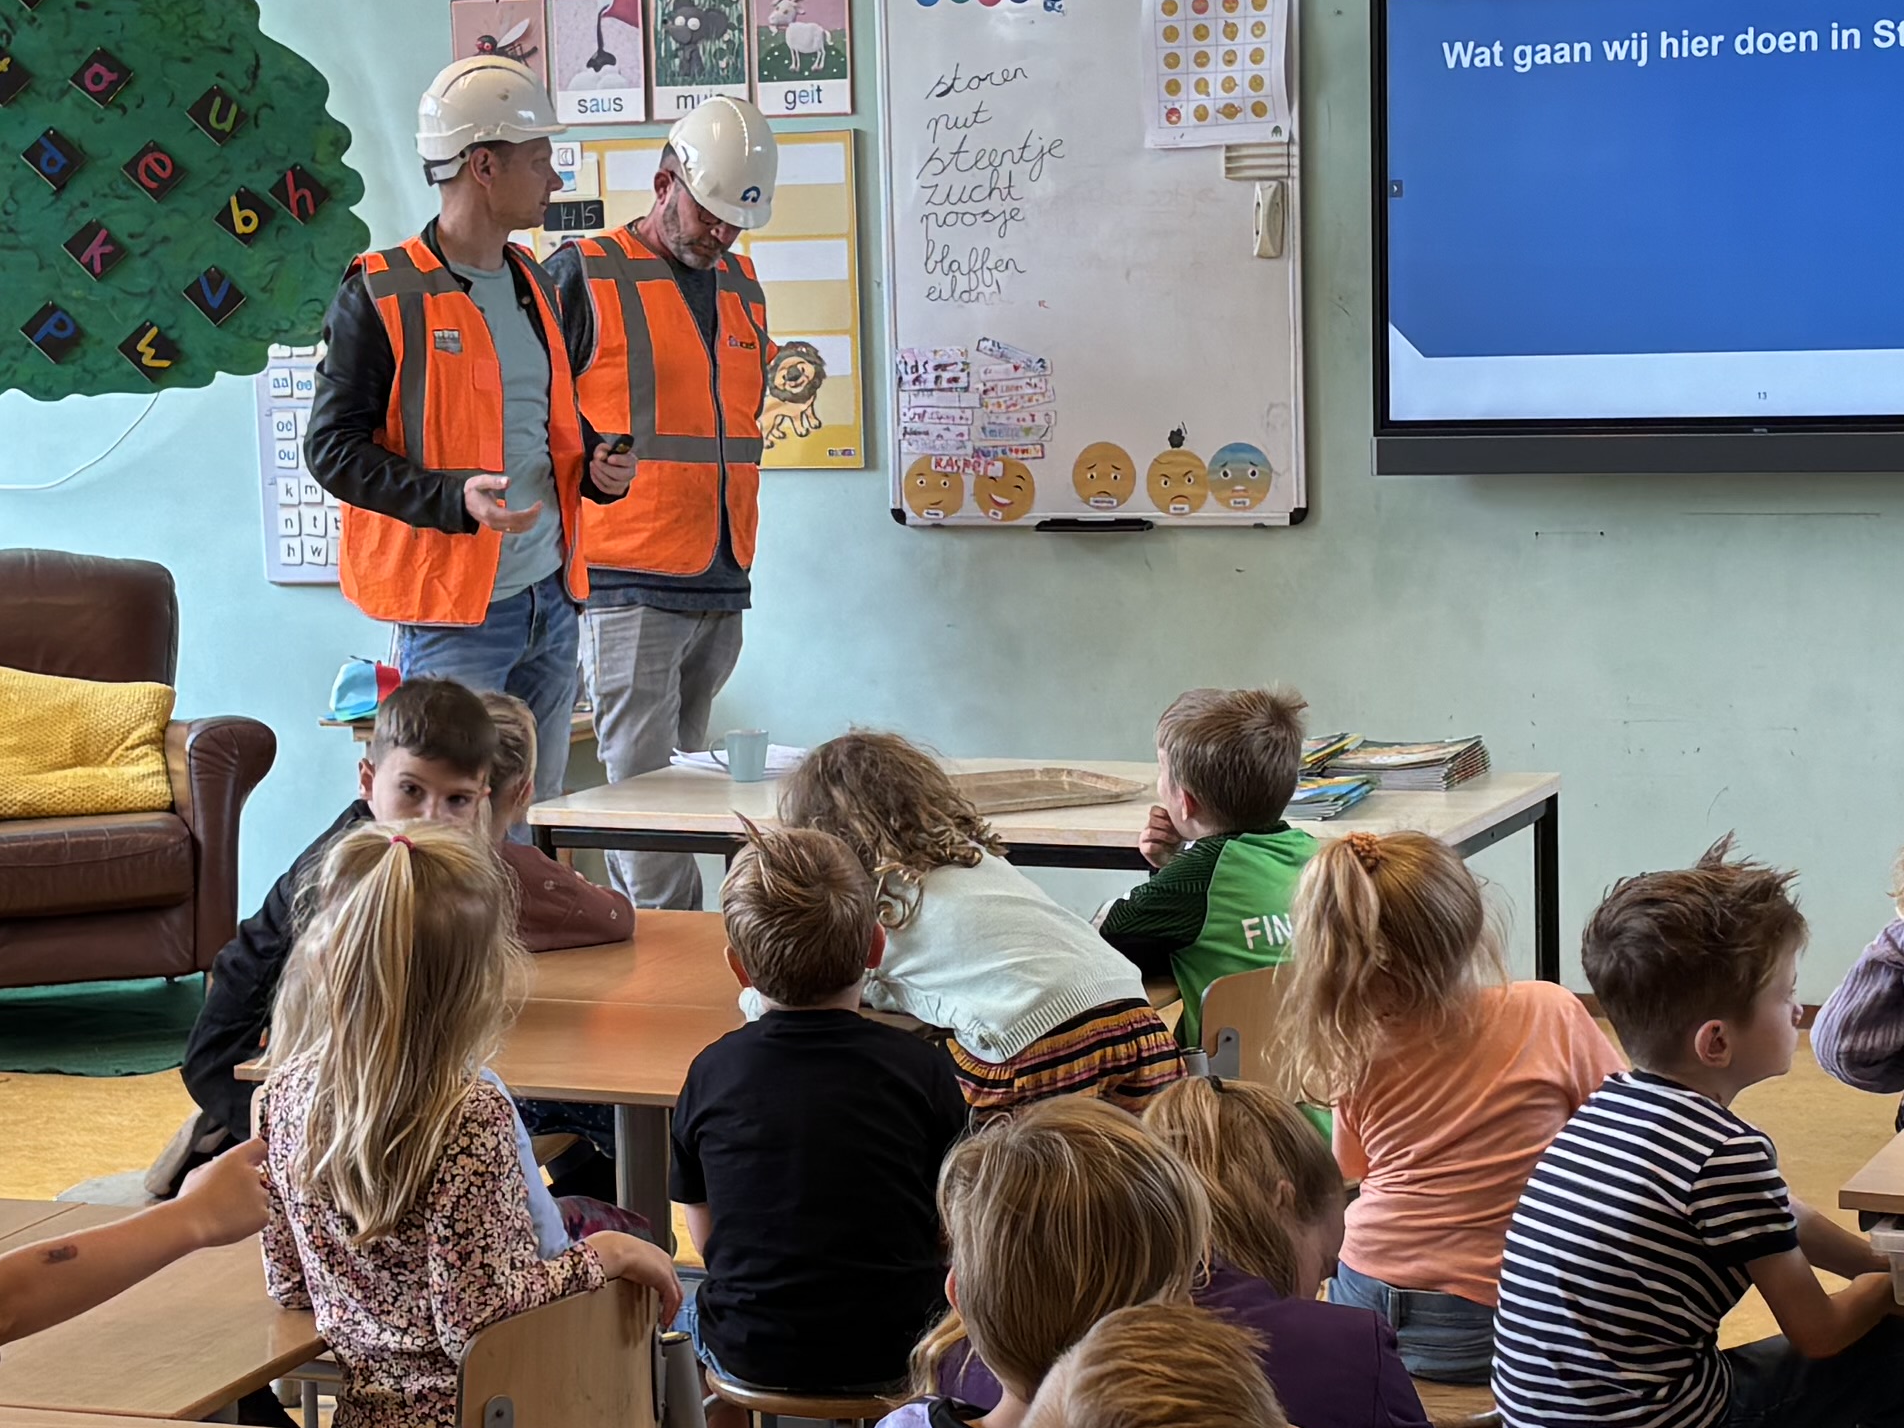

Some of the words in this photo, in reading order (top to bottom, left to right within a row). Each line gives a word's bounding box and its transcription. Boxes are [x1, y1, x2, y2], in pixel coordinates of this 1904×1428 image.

[1443, 40, 1503, 69] Wat
[1513, 39, 1592, 73] gaan
[1602, 31, 1649, 67] wij
[1659, 29, 1724, 60] hier
[1734, 26, 1819, 56] doen
[1830, 21, 1862, 51] in
[84, 62, 119, 93] a
[925, 62, 1028, 99] storen
[209, 95, 238, 133] u
[577, 95, 623, 114] saus
[784, 83, 823, 112] geit
[136, 150, 174, 190] e
[916, 128, 1065, 182] steentje
[285, 169, 316, 218] h
[920, 169, 1024, 207] zucht
[230, 193, 260, 235] b
[79, 227, 115, 272] k
[924, 238, 1027, 291] blaffen
[1757, 391, 1768, 400] 13
[285, 483, 294, 497] k
[304, 484, 318, 495] m
[284, 517, 294, 529] n
[312, 514, 318, 529] t
[286, 543, 296, 557] h
[310, 544, 323, 557] w
